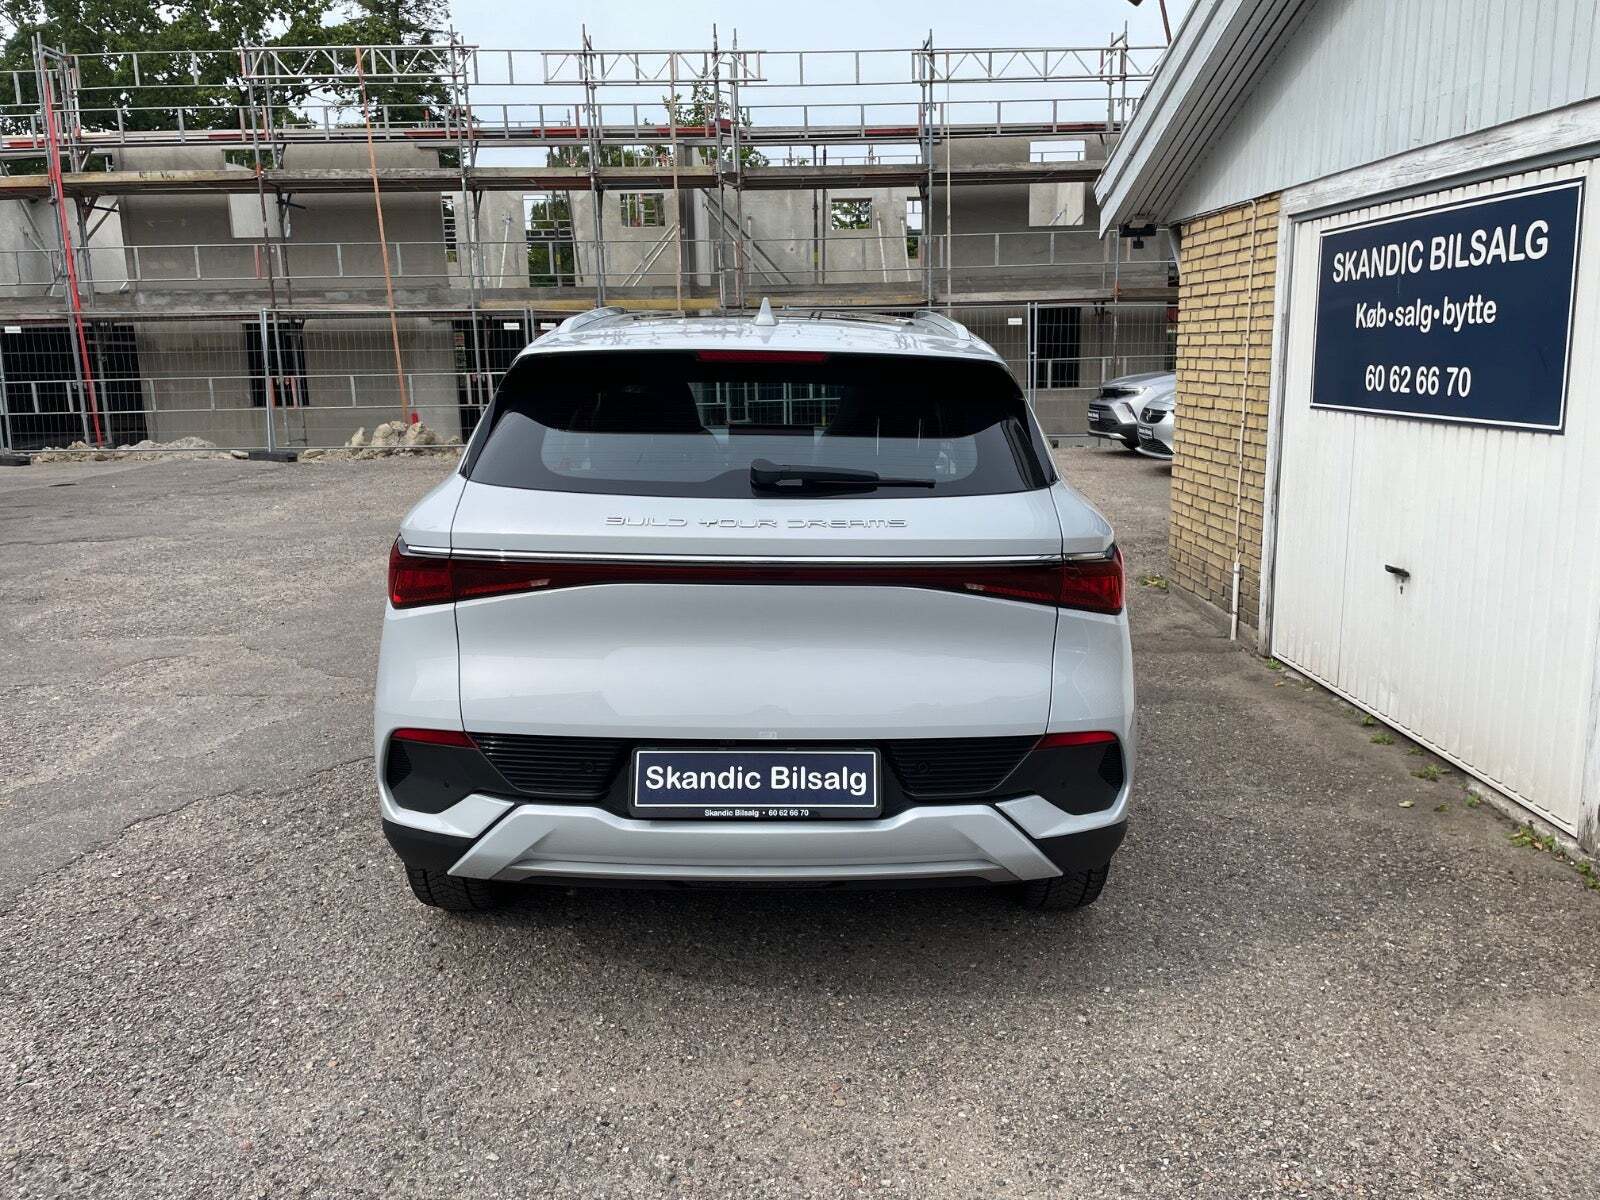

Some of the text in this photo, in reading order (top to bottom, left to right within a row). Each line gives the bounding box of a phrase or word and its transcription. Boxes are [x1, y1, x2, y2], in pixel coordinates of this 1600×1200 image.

[1332, 219, 1549, 283] SKANDIC BILSALG
[1365, 364, 1472, 398] 60 62 66 70
[605, 515, 908, 528] BUILD YOUR DREAMS
[645, 765, 867, 796] Skandic Bilsalg
[704, 809, 809, 818] Skandic Bilsalg 60 62 66 70
